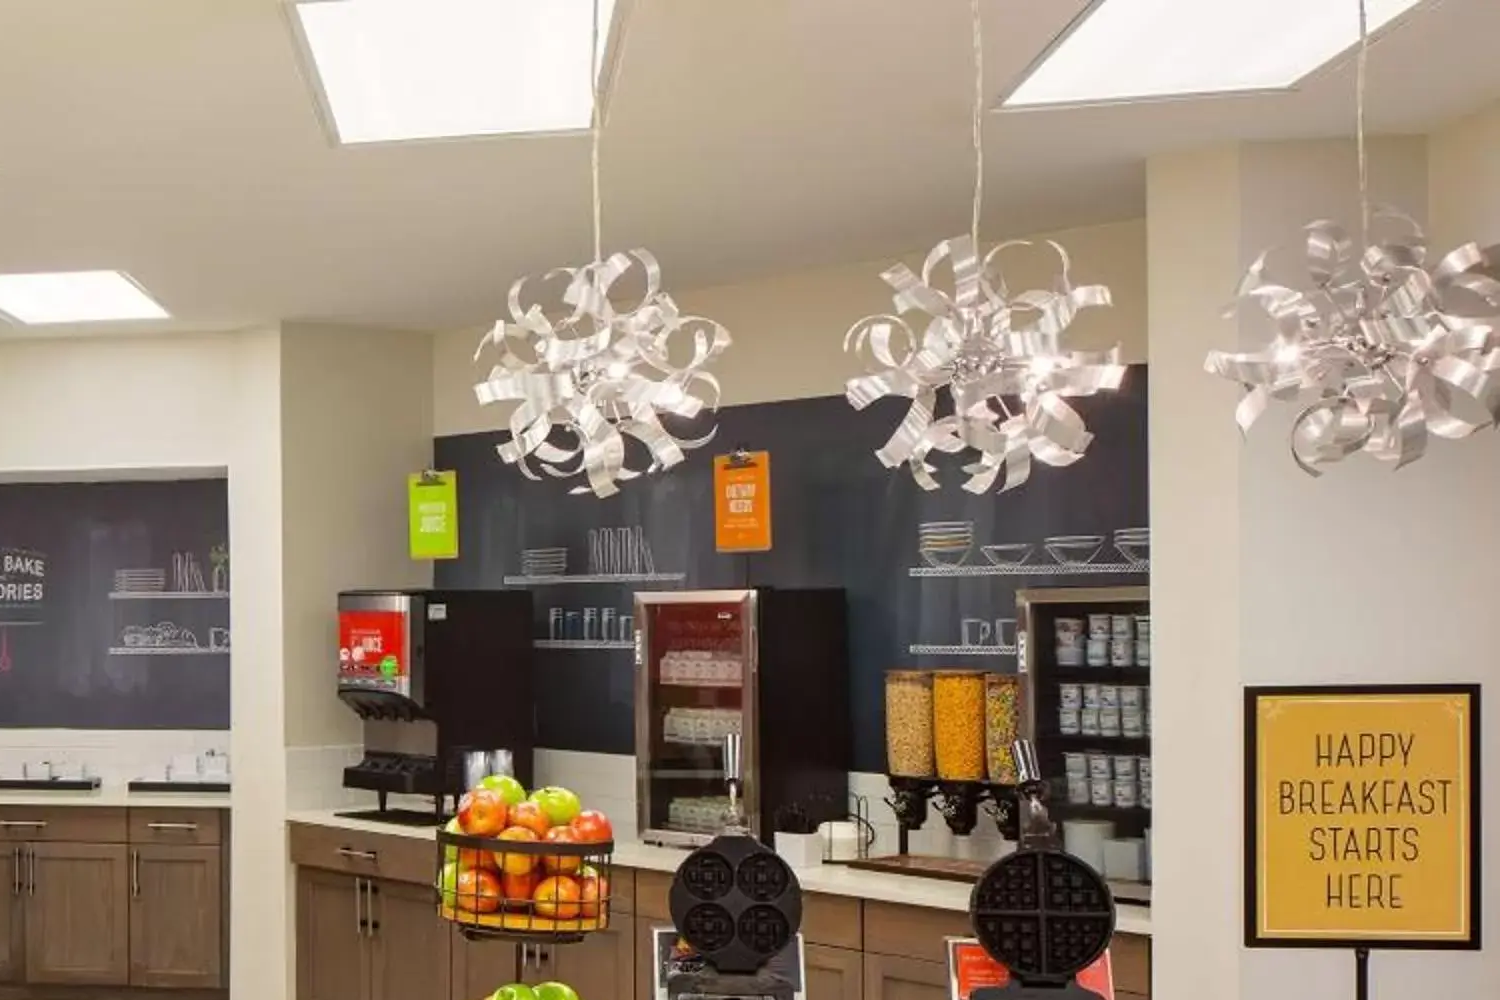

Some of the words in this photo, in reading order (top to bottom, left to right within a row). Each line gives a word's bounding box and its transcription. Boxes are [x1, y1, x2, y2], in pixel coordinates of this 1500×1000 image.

[3, 555, 45, 577] BAKE
[1315, 733, 1415, 767] HAPPY
[1279, 779, 1452, 815] BREAKFAST
[1309, 827, 1419, 861] STARTS
[1326, 873, 1403, 909] HERE
